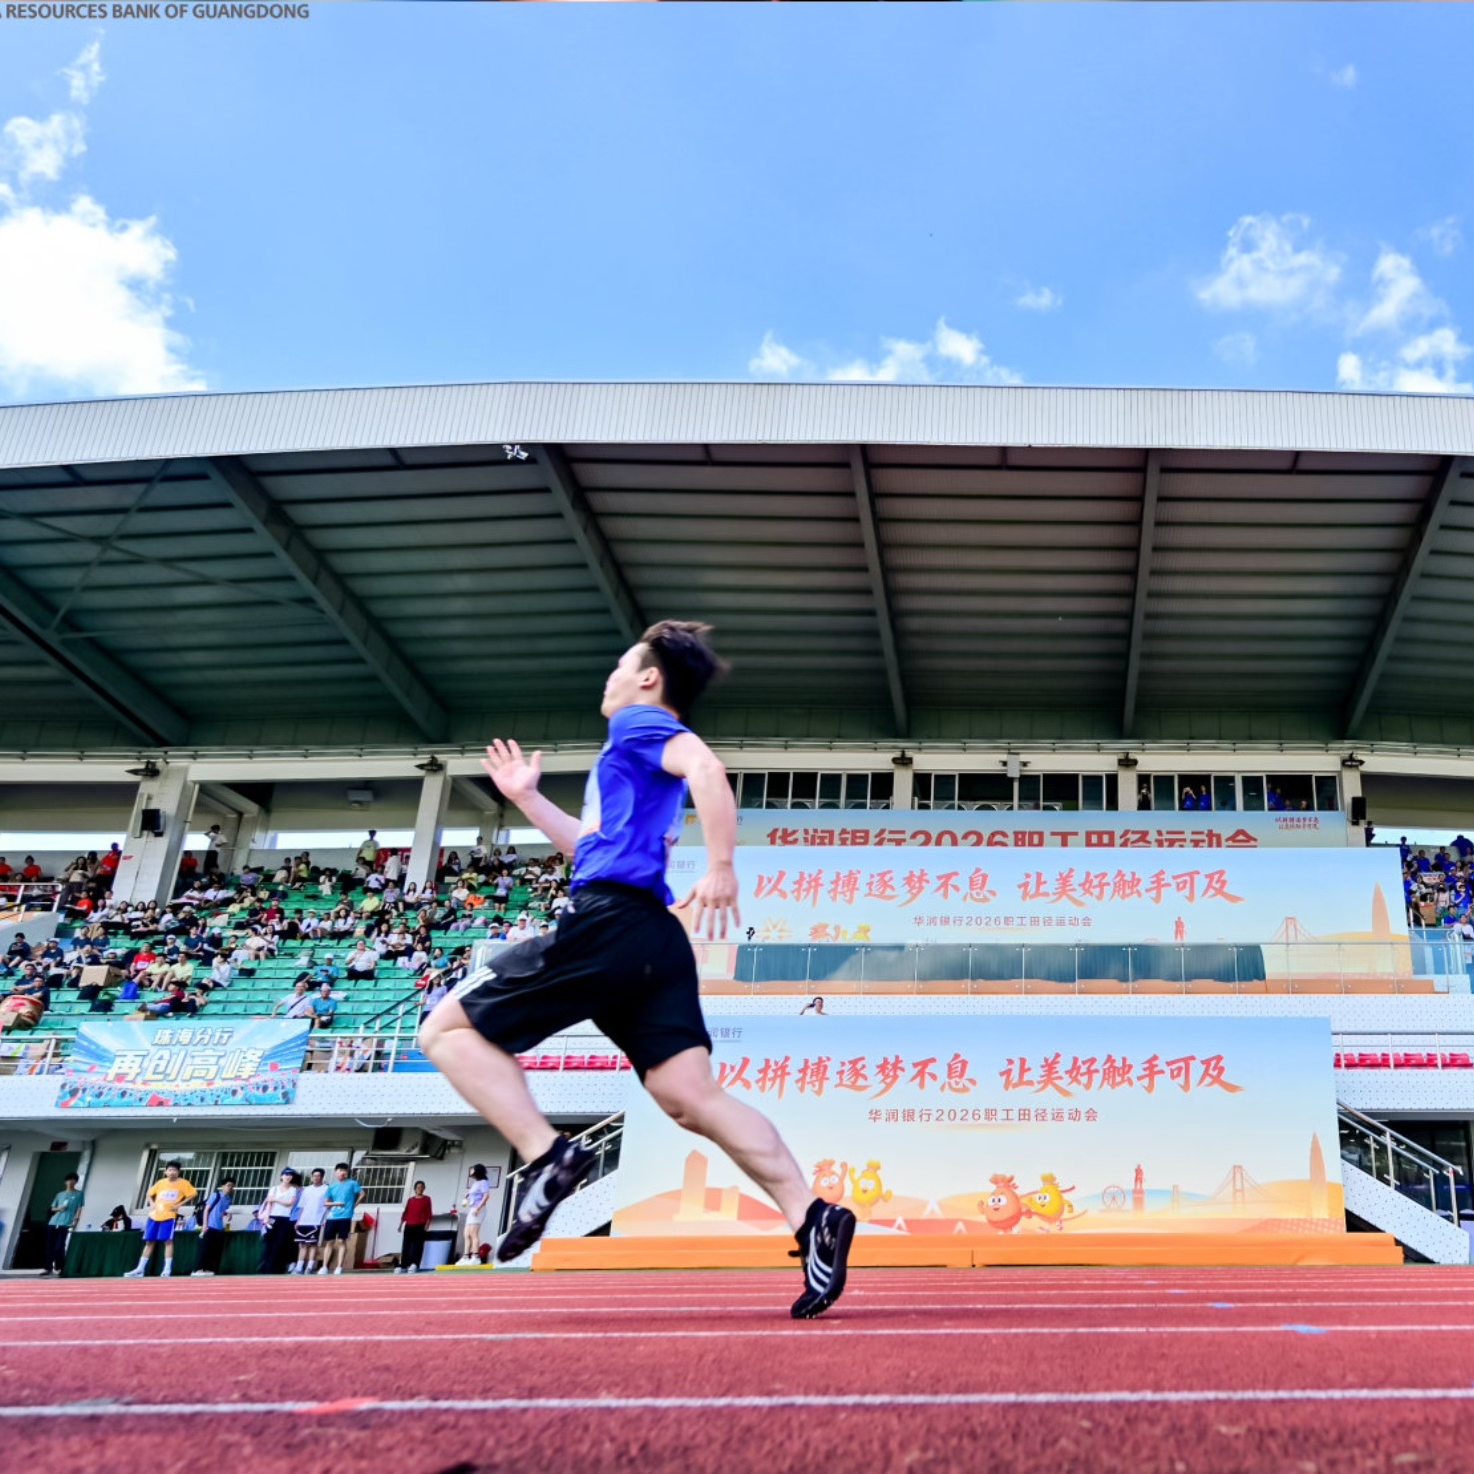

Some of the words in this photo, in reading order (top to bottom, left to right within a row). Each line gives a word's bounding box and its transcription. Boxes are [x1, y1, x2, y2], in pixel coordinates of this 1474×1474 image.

[753, 867, 998, 908] 以拼搏逐梦不息
[1017, 867, 1245, 908] 让美好触手可及
[152, 1026, 234, 1047] 珠海分行
[107, 1048, 265, 1082] 再创高峰
[715, 1052, 979, 1101] 以拼搏逐梦不息
[999, 1052, 1246, 1099] 让美好触手可及
[868, 1108, 1099, 1124] 华润银行2026职工田径运动会
